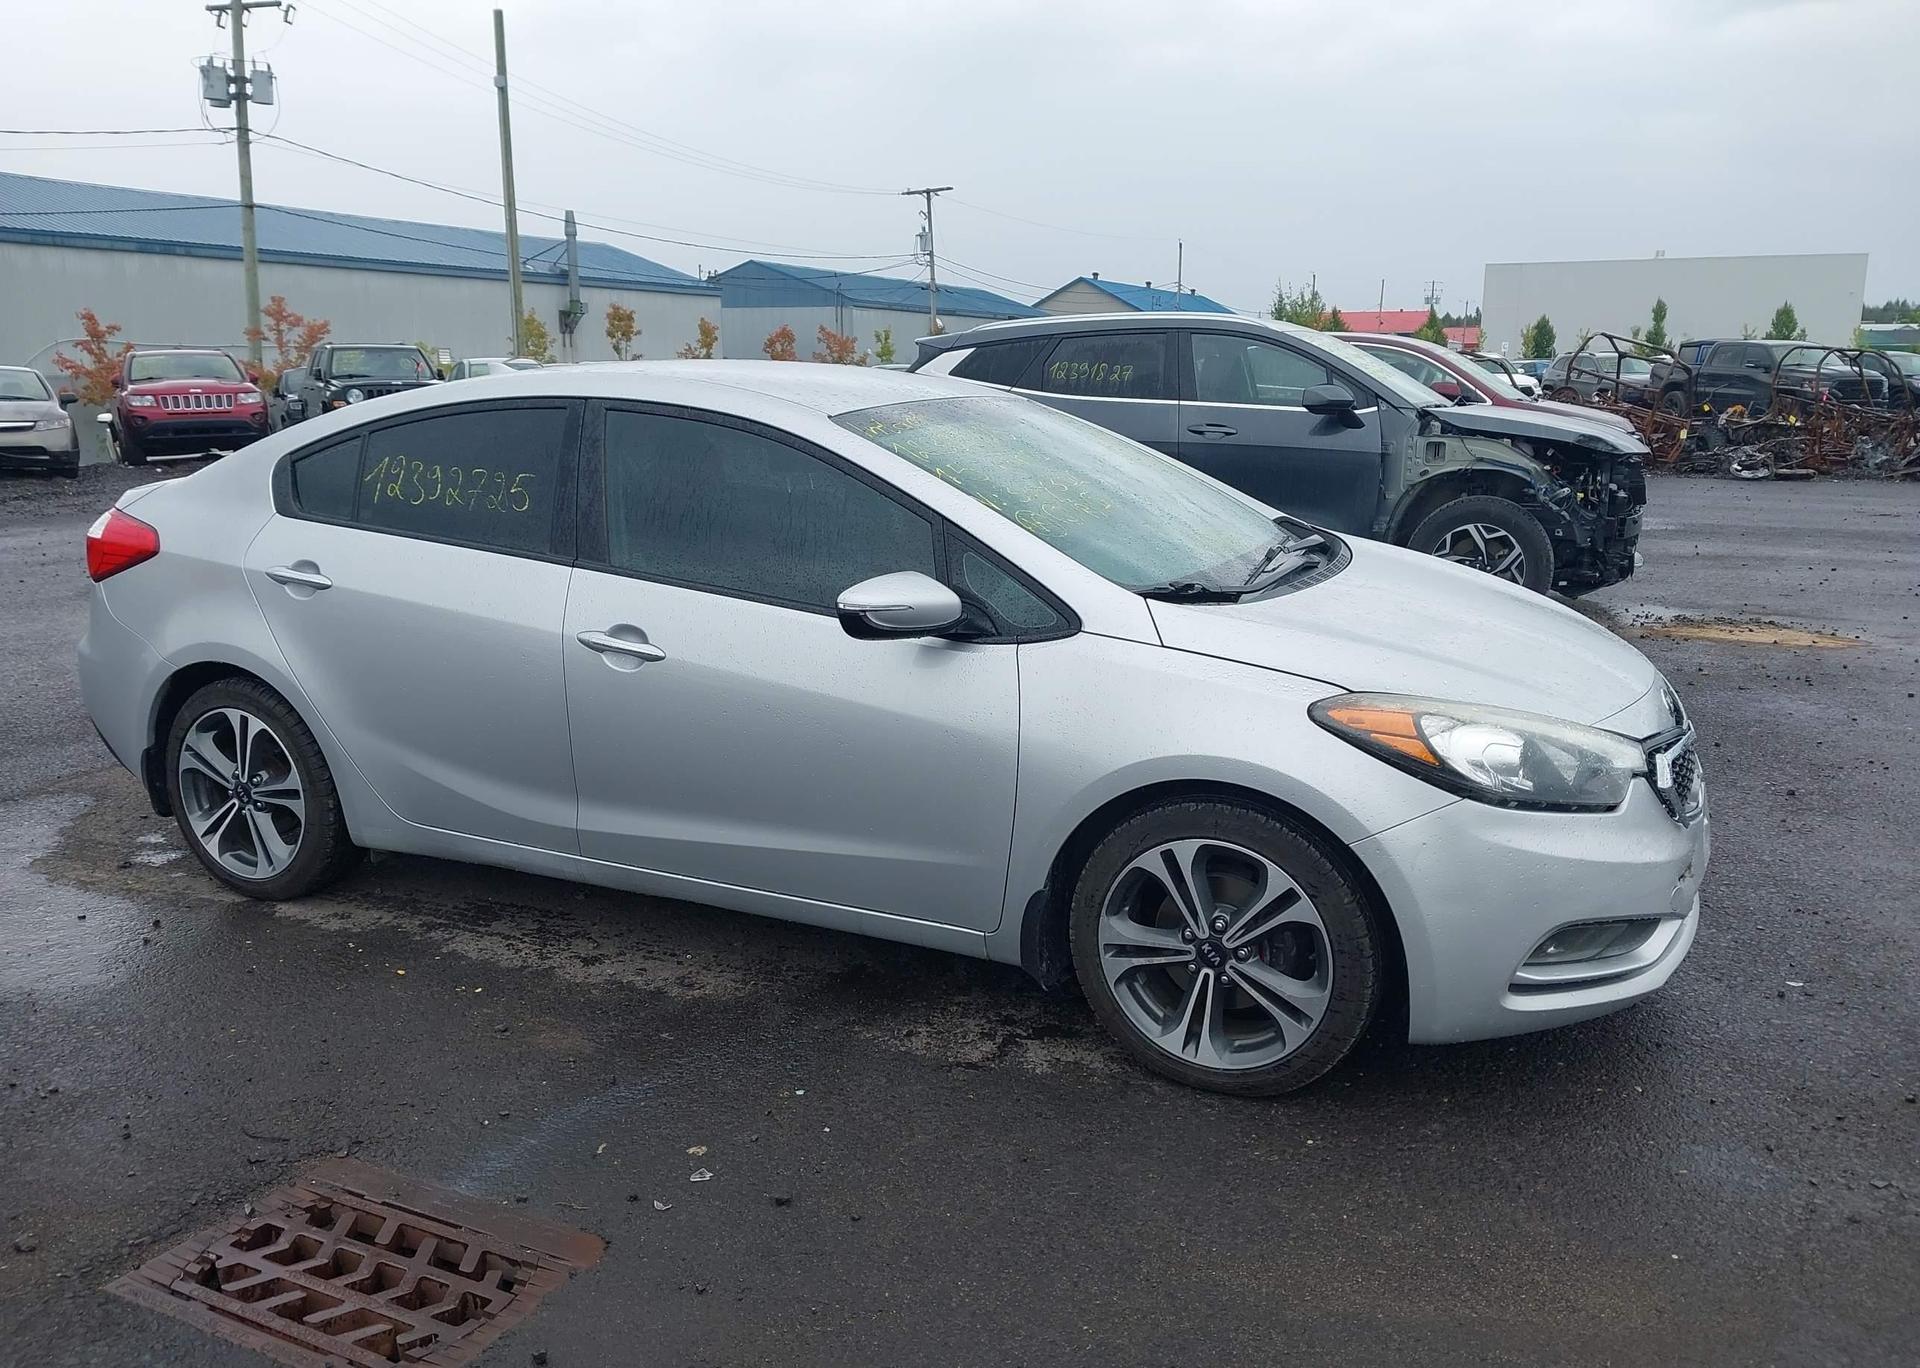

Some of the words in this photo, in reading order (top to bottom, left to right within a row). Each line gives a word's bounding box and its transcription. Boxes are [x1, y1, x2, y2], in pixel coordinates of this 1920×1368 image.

[1049, 361, 1134, 382] 12391827
[364, 455, 536, 513] 12392725
[1201, 942, 1221, 966] KIA
